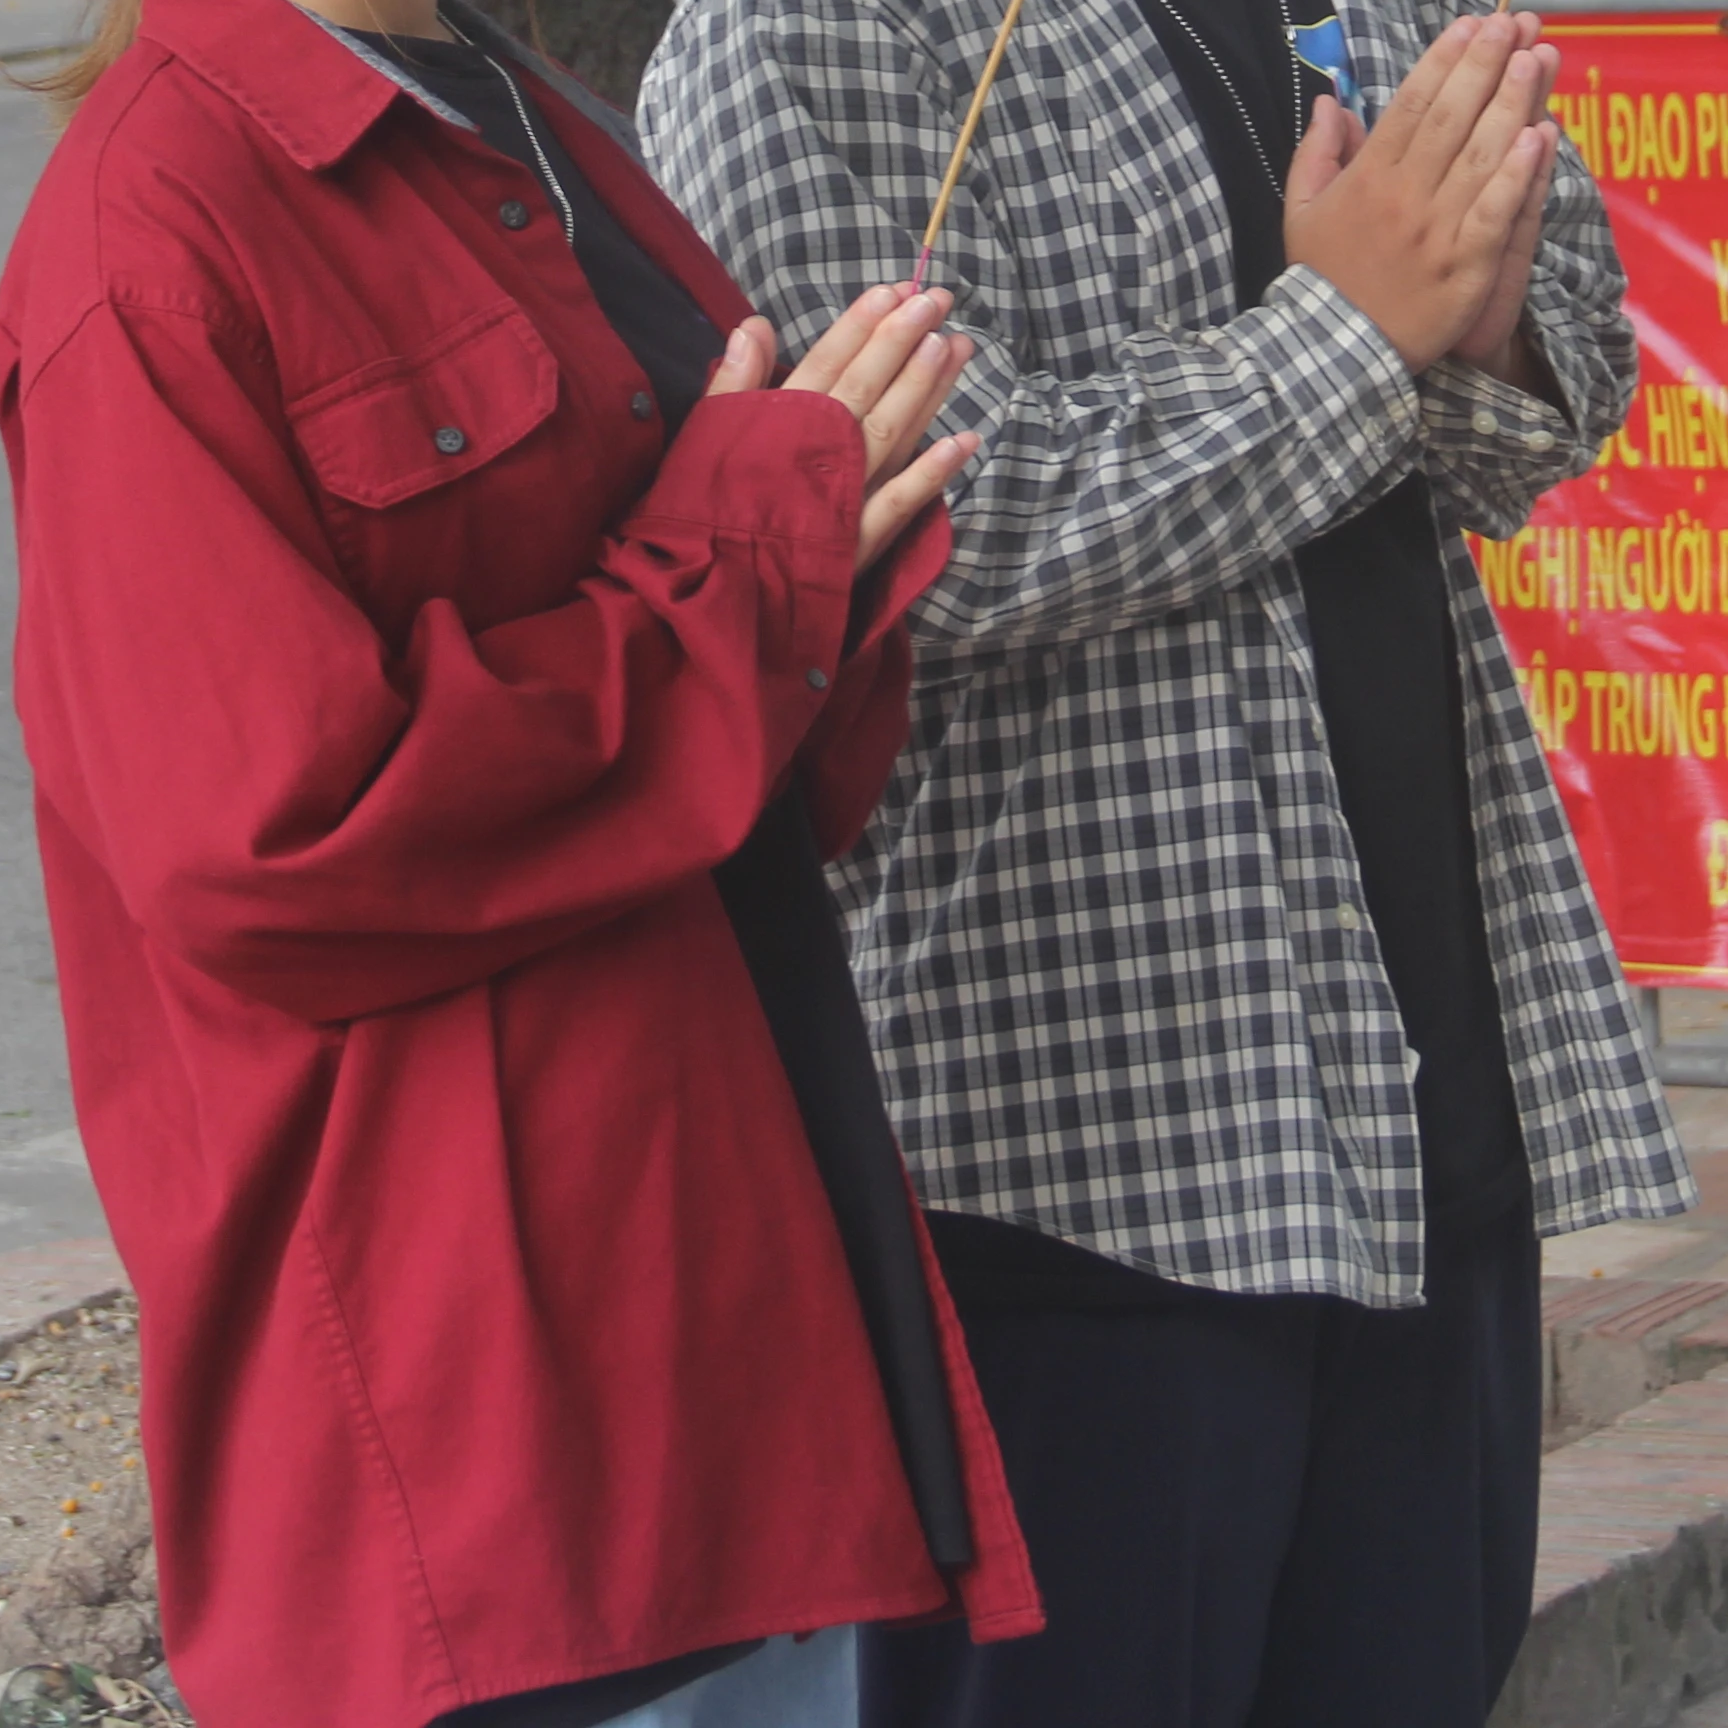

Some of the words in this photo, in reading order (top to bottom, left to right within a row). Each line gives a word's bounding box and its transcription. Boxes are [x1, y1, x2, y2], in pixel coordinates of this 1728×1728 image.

[1607, 90, 1691, 206] ĐẠO
[1587, 508, 1712, 617] NGƯỜI
[1582, 669, 1719, 760] TRUNG
